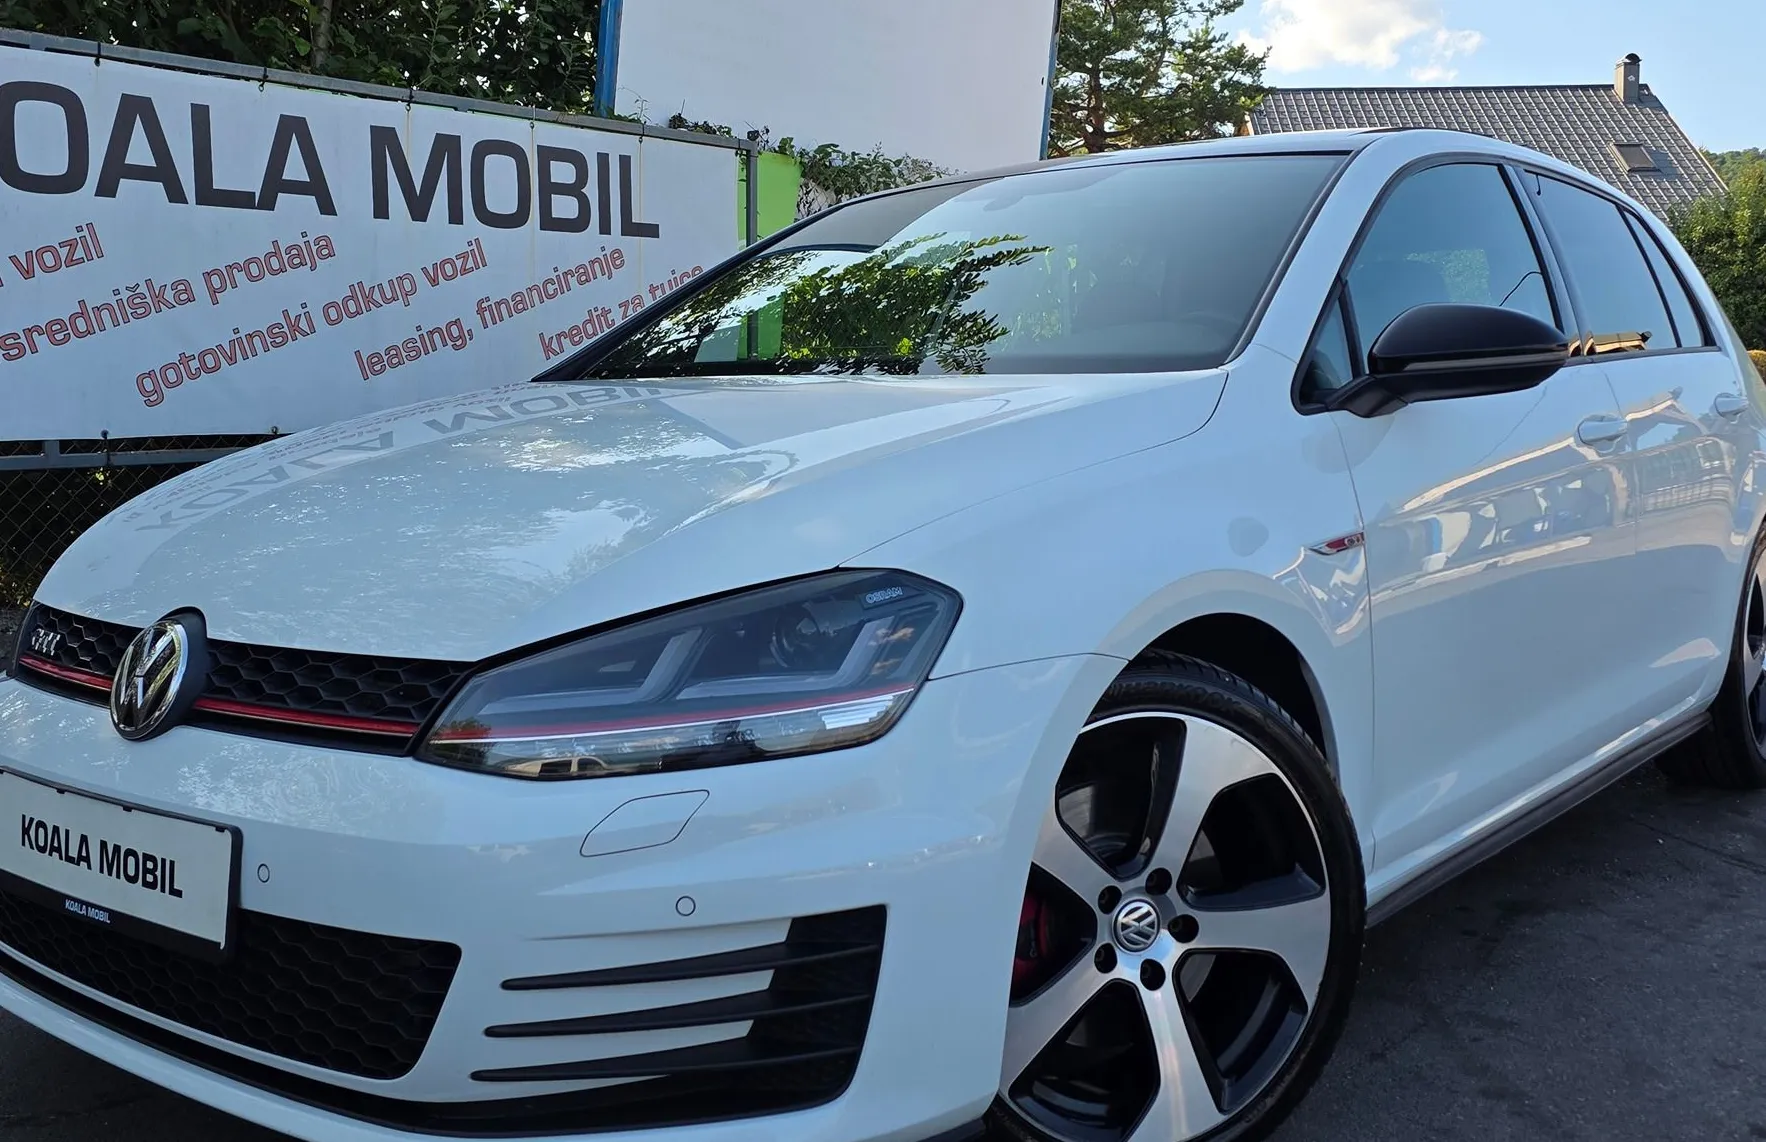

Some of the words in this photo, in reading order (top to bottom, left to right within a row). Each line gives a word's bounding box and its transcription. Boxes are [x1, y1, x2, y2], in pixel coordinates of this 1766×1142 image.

[369, 125, 660, 239] MOBIL
[9, 222, 104, 280] vozil
[0, 278, 196, 361] sredniška
[202, 231, 336, 305] prodaja
[136, 302, 316, 407] gotovinski
[322, 272, 418, 327] odkup
[421, 238, 488, 287] vozil
[354, 317, 474, 381] leasing,
[476, 246, 626, 329] financiranje
[538, 306, 616, 360] kredit
[618, 294, 645, 320] za
[865, 586, 904, 604] OSRAM
[21, 813, 92, 871] KOALA
[98, 838, 183, 899] MOBIL
[65, 898, 87, 916] KOALA
[87, 906, 111, 924] MOBIL
